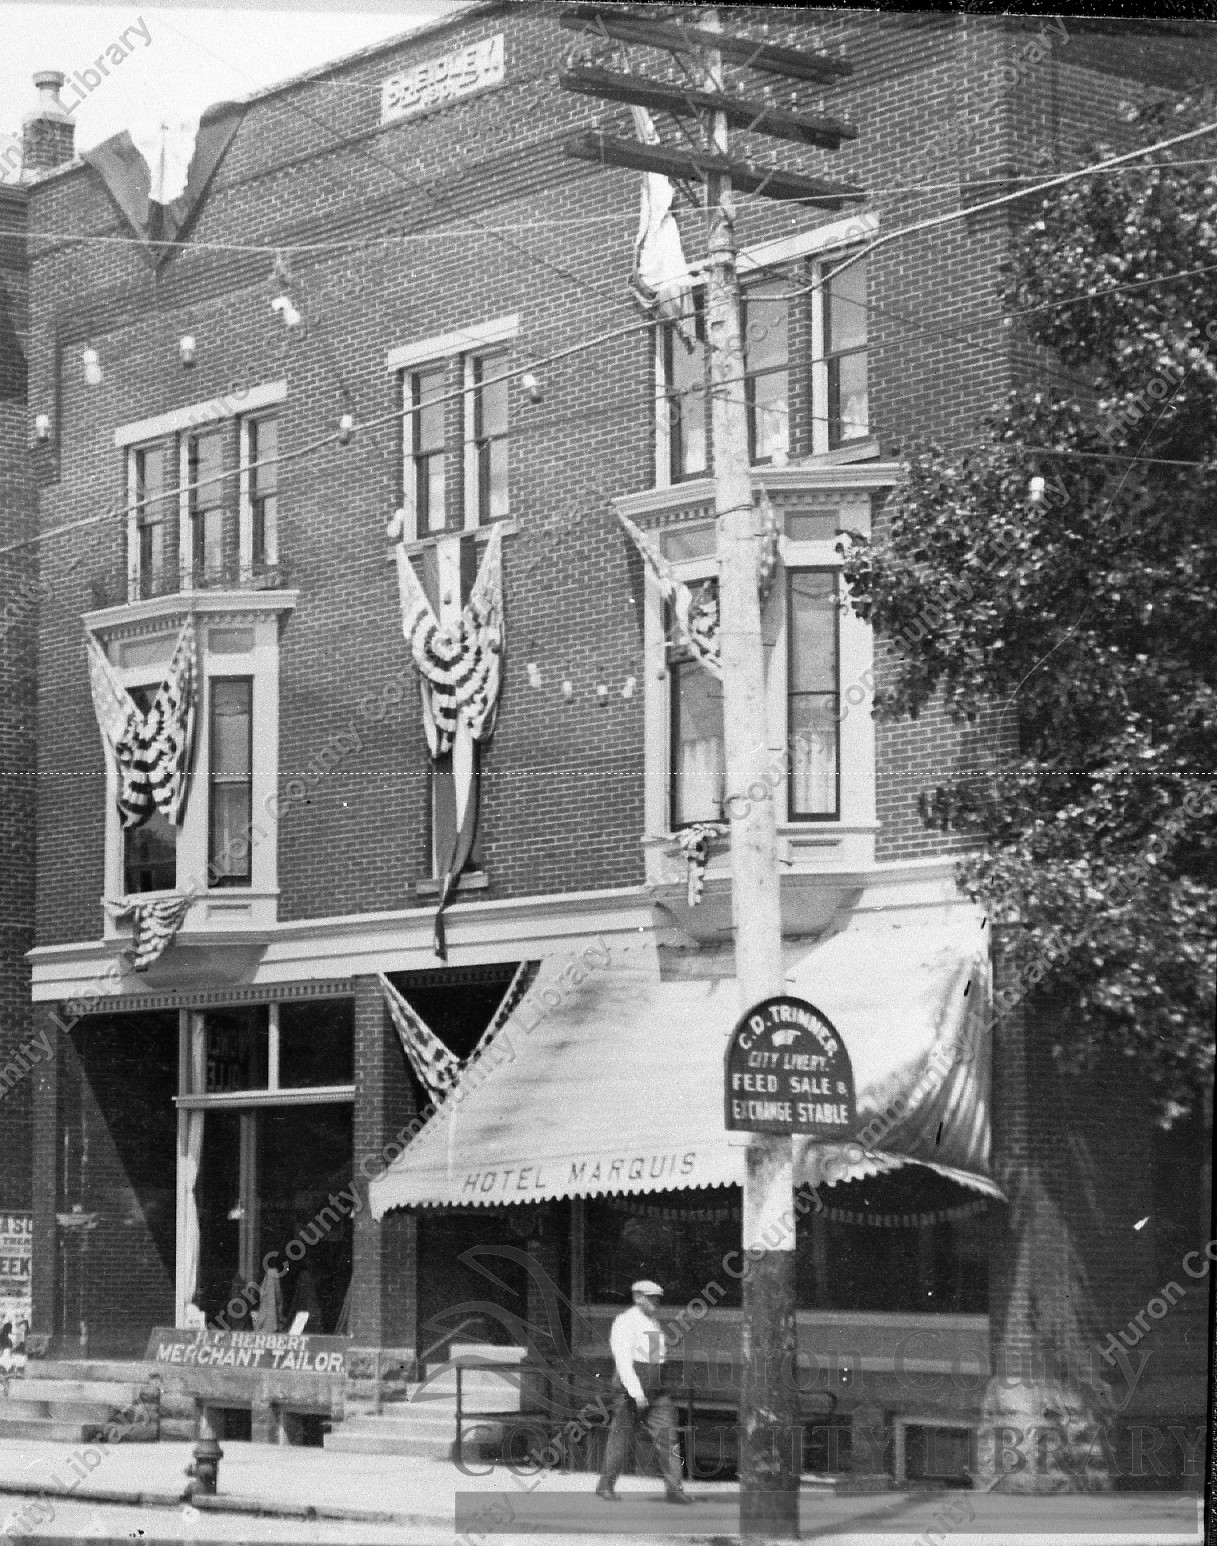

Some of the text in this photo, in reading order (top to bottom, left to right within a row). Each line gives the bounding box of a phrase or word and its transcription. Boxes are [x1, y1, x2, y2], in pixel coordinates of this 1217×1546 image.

[747, 1051, 780, 1068] CITY
[732, 1073, 779, 1093] FEED
[789, 1075, 833, 1095] SALE
[796, 1102, 849, 1125] STABLE
[463, 1152, 697, 1193] HOTEL MARQUIS
[231, 1333, 310, 1351] HERBERT
[155, 1343, 265, 1368] MERCHANT
